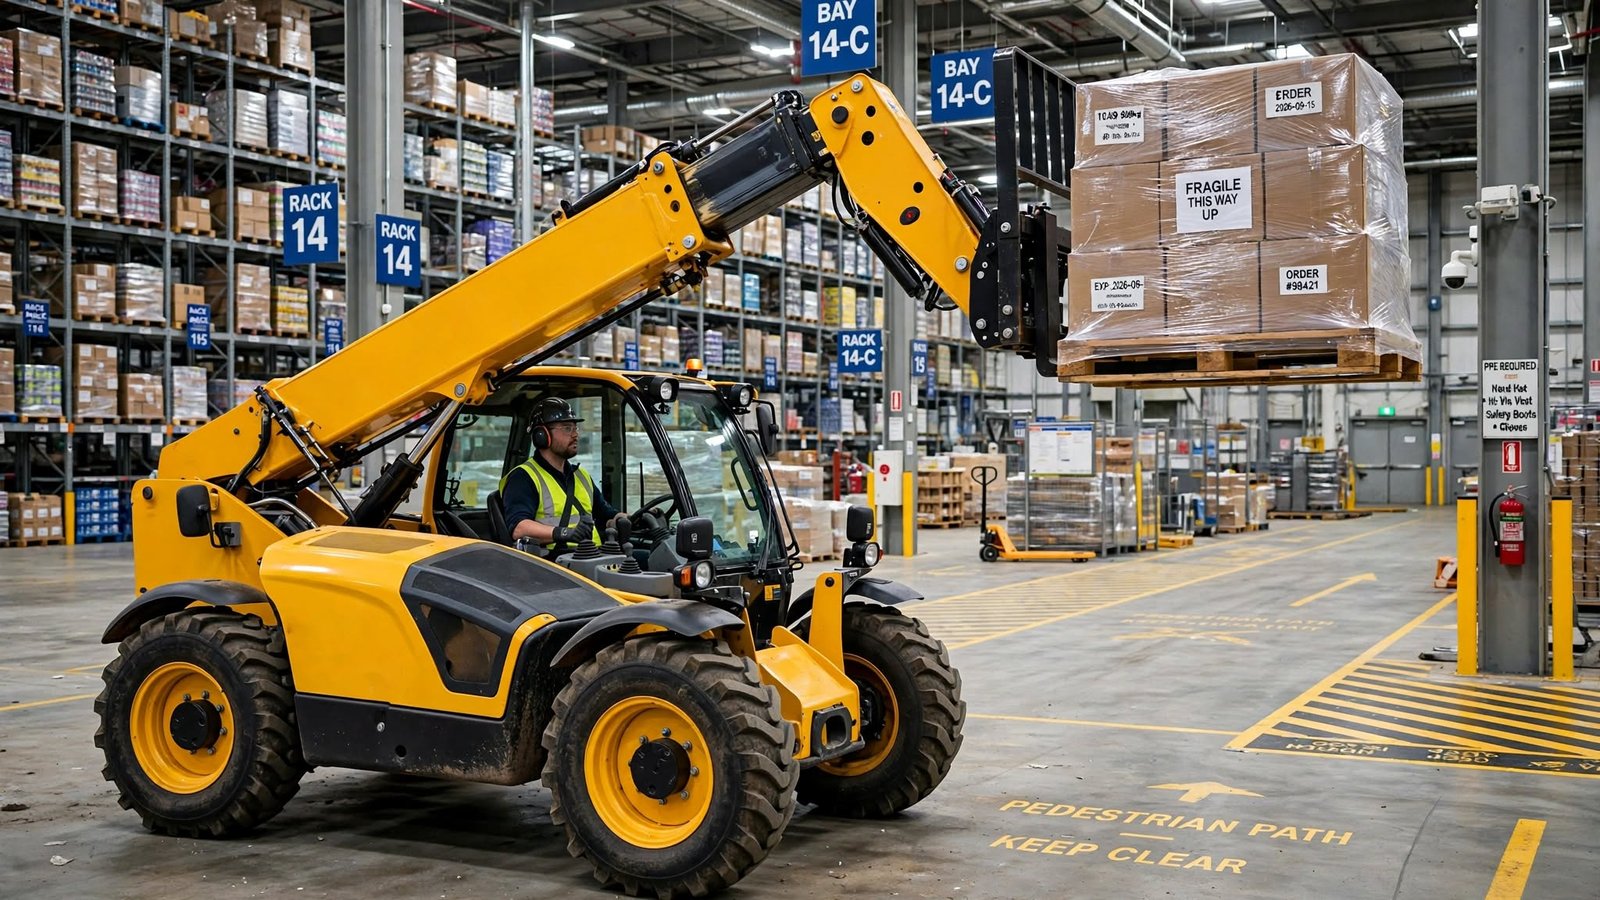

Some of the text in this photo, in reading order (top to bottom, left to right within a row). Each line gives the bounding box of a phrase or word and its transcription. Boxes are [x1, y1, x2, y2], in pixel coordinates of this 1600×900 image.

[817, 0, 857, 23] BAY
[808, 25, 869, 60] 14-C
[944, 57, 980, 77] BAY
[937, 80, 992, 109] 14-C
[1186, 178, 1241, 195] FRAGILE
[289, 191, 332, 212] RACK
[1187, 193, 1238, 208] THIS WAY
[1202, 208, 1218, 220] UP
[292, 216, 328, 252] 14
[381, 221, 416, 241] RACK
[383, 243, 412, 276] 14
[1286, 269, 1319, 279] ORDER
[842, 334, 876, 347] RACK
[842, 349, 876, 366] 14-C
[1484, 362, 1498, 371] PPE
[1000, 800, 1353, 845] PEDESTRIAN PATH
[990, 834, 1248, 874] KEEP CLEAR
